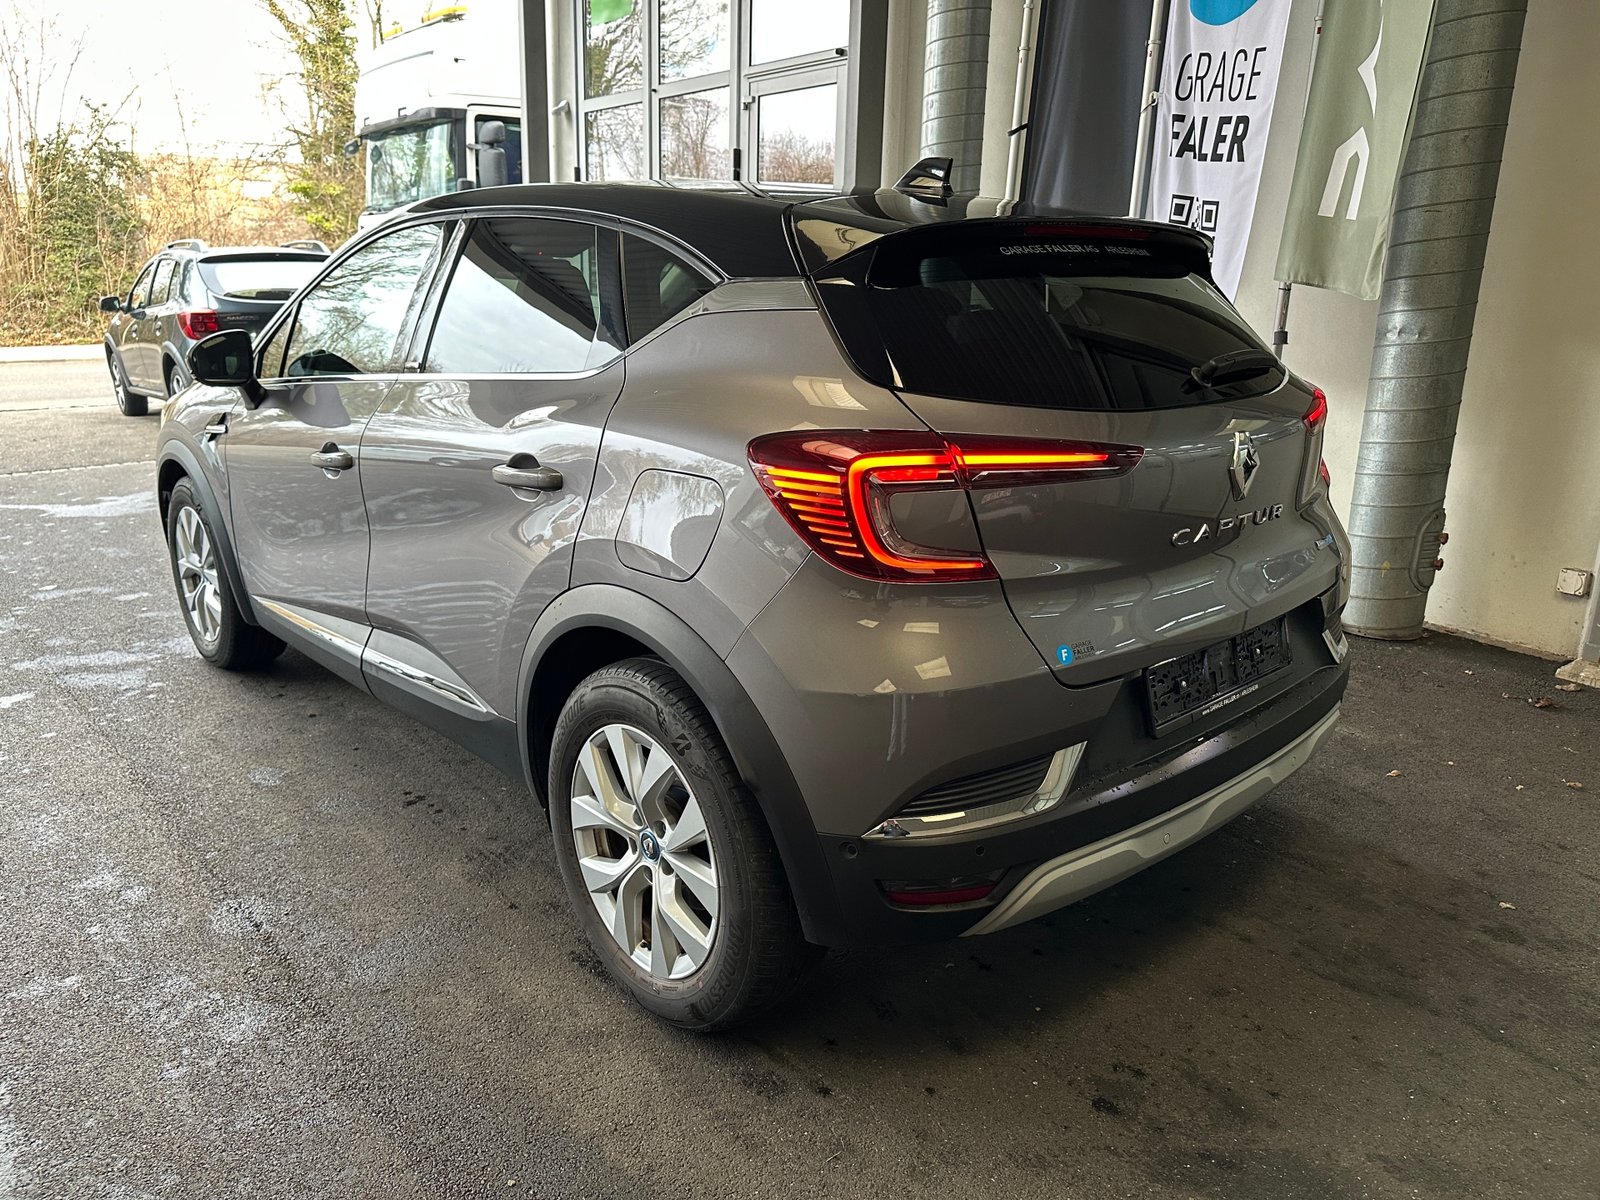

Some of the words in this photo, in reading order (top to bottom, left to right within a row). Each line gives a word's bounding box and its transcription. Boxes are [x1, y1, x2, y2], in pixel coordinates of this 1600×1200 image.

[1000, 245, 1046, 255] GARAGE
[1045, 244, 1085, 253] FALLER
[1171, 503, 1283, 547] CAPTUR
[1073, 646, 1095, 655] FALLER
